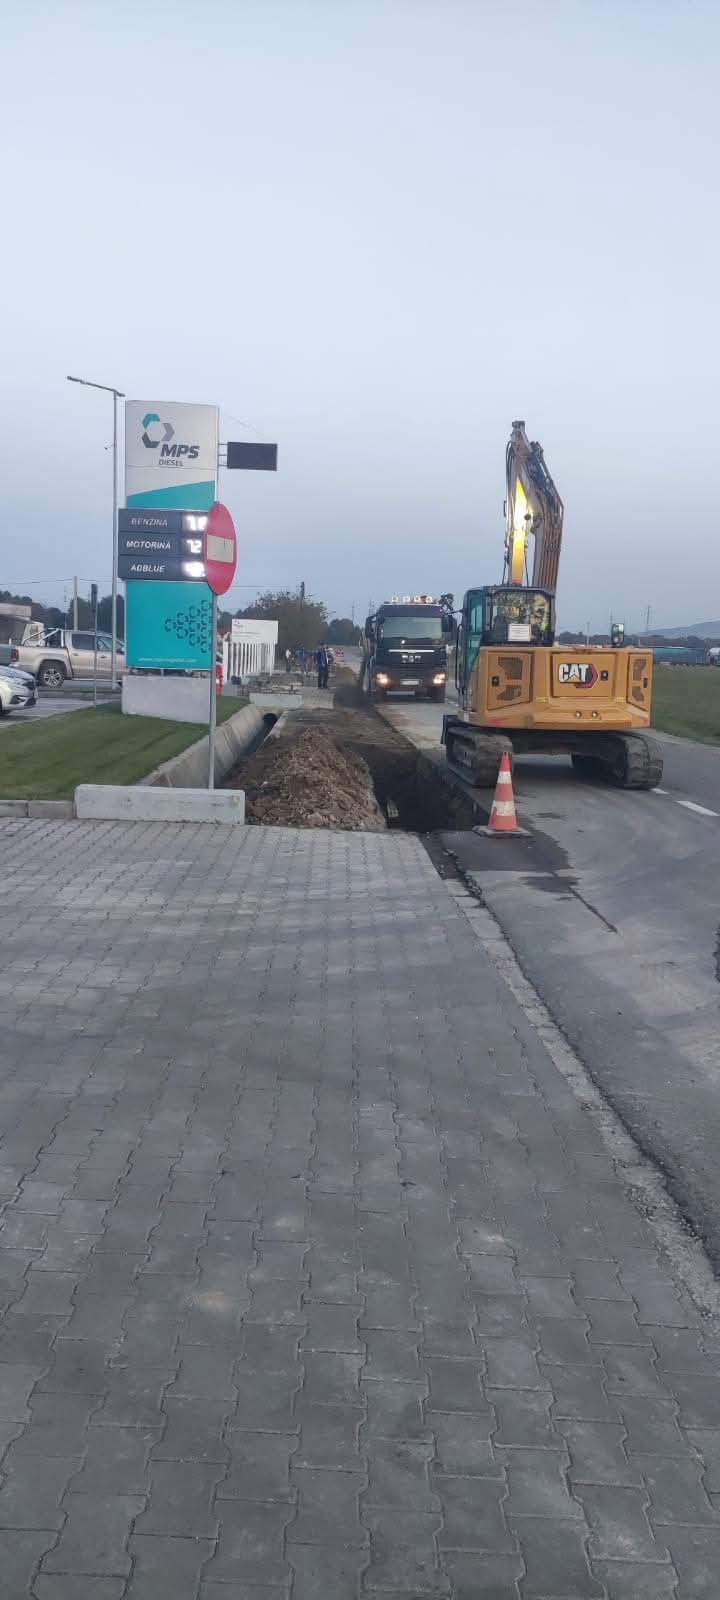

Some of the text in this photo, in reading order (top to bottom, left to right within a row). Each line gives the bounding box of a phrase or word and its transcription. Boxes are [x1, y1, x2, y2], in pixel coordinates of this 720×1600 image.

[160, 443, 200, 459] MPS
[158, 459, 184, 467] DIESEL
[131, 517, 168, 527] BENZINA
[130, 563, 166, 573] ADBLUE
[558, 663, 589, 683] CAT
